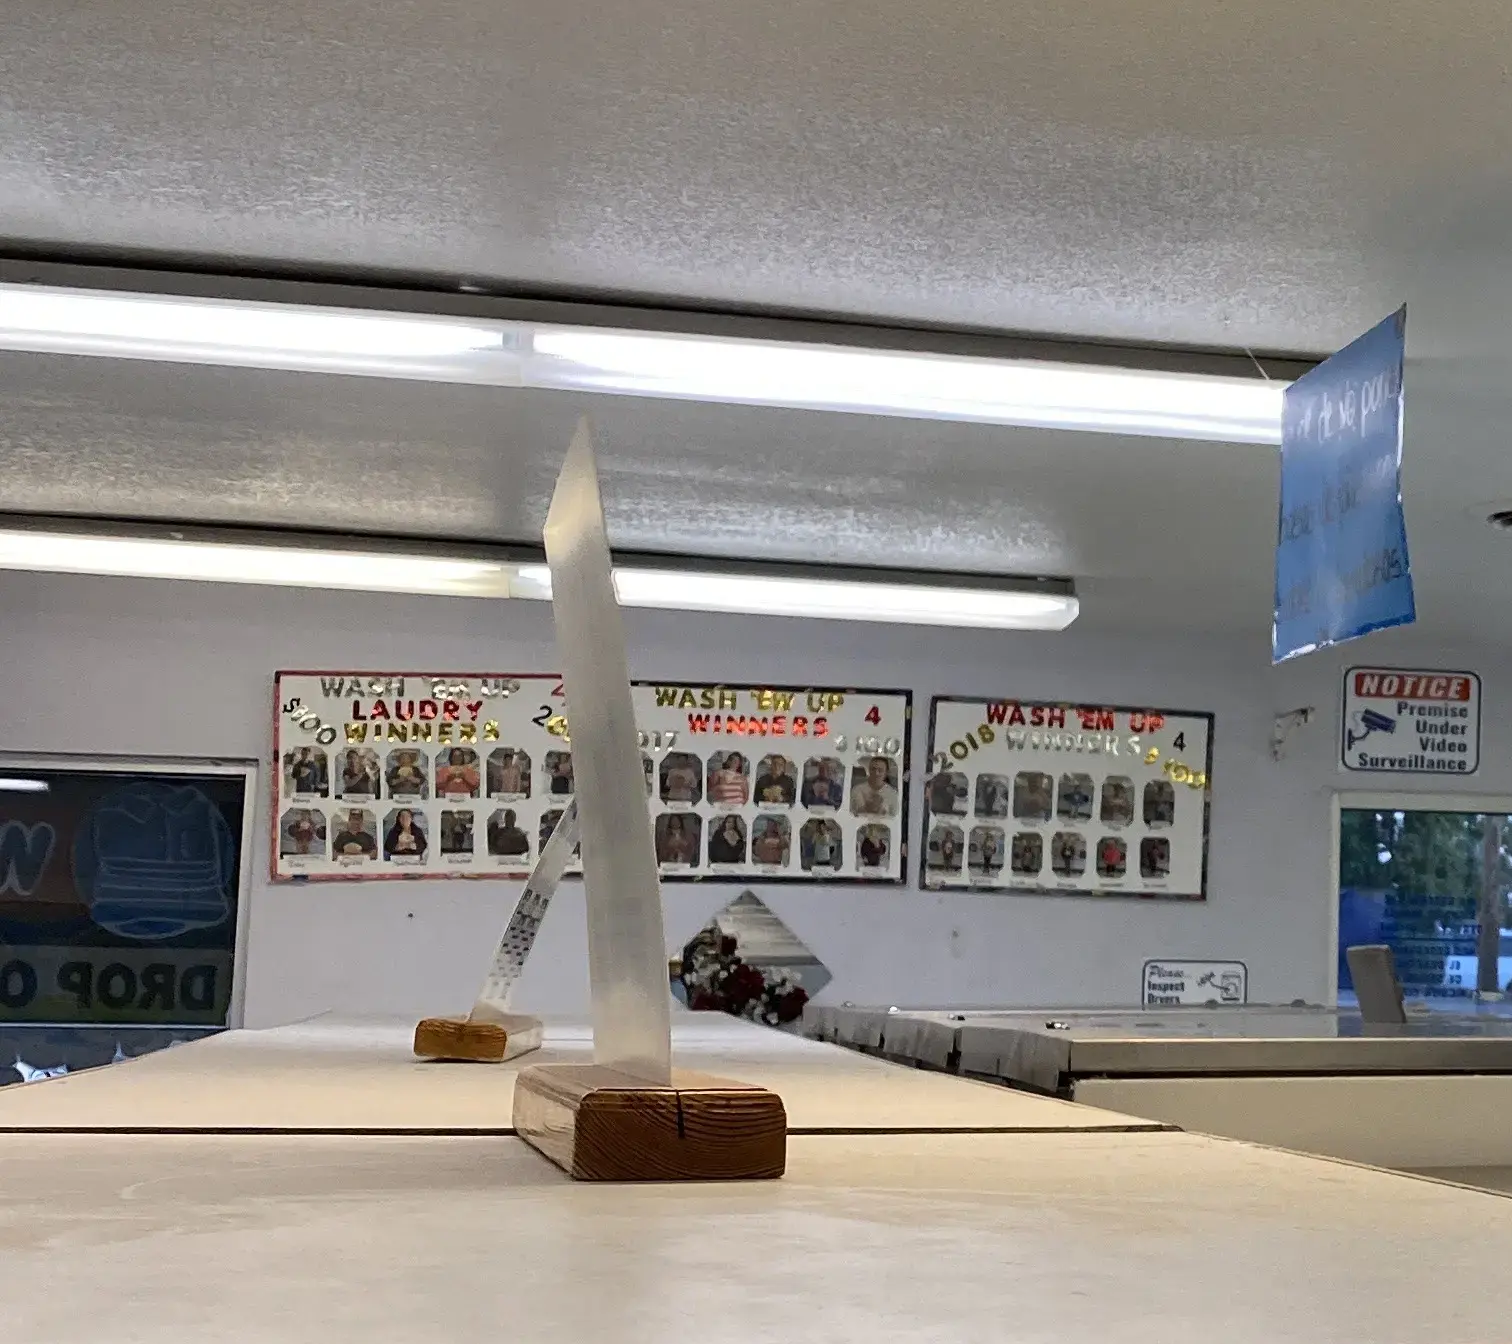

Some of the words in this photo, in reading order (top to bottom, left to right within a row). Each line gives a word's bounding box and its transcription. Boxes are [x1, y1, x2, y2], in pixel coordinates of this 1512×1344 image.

[320, 676, 405, 698] WASH
[480, 677, 521, 699] UP
[1361, 675, 1464, 699] NOTICE
[352, 699, 483, 721] LAUDRY
[655, 687, 737, 710] WASH
[807, 692, 844, 713] UP
[1397, 702, 1468, 718] Premise
[688, 712, 829, 738] WINNERS
[865, 705, 881, 725] 4
[986, 703, 1065, 729] WASH
[1130, 710, 1165, 733] UP
[344, 719, 500, 744] WINNERS
[1416, 720, 1468, 735] Under
[930, 724, 995, 774] 2018
[1005, 726, 1141, 756] WINNERS
[1173, 732, 1187, 751] 4
[1420, 736, 1467, 753] Video
[1358, 752, 1467, 770] Surveillance
